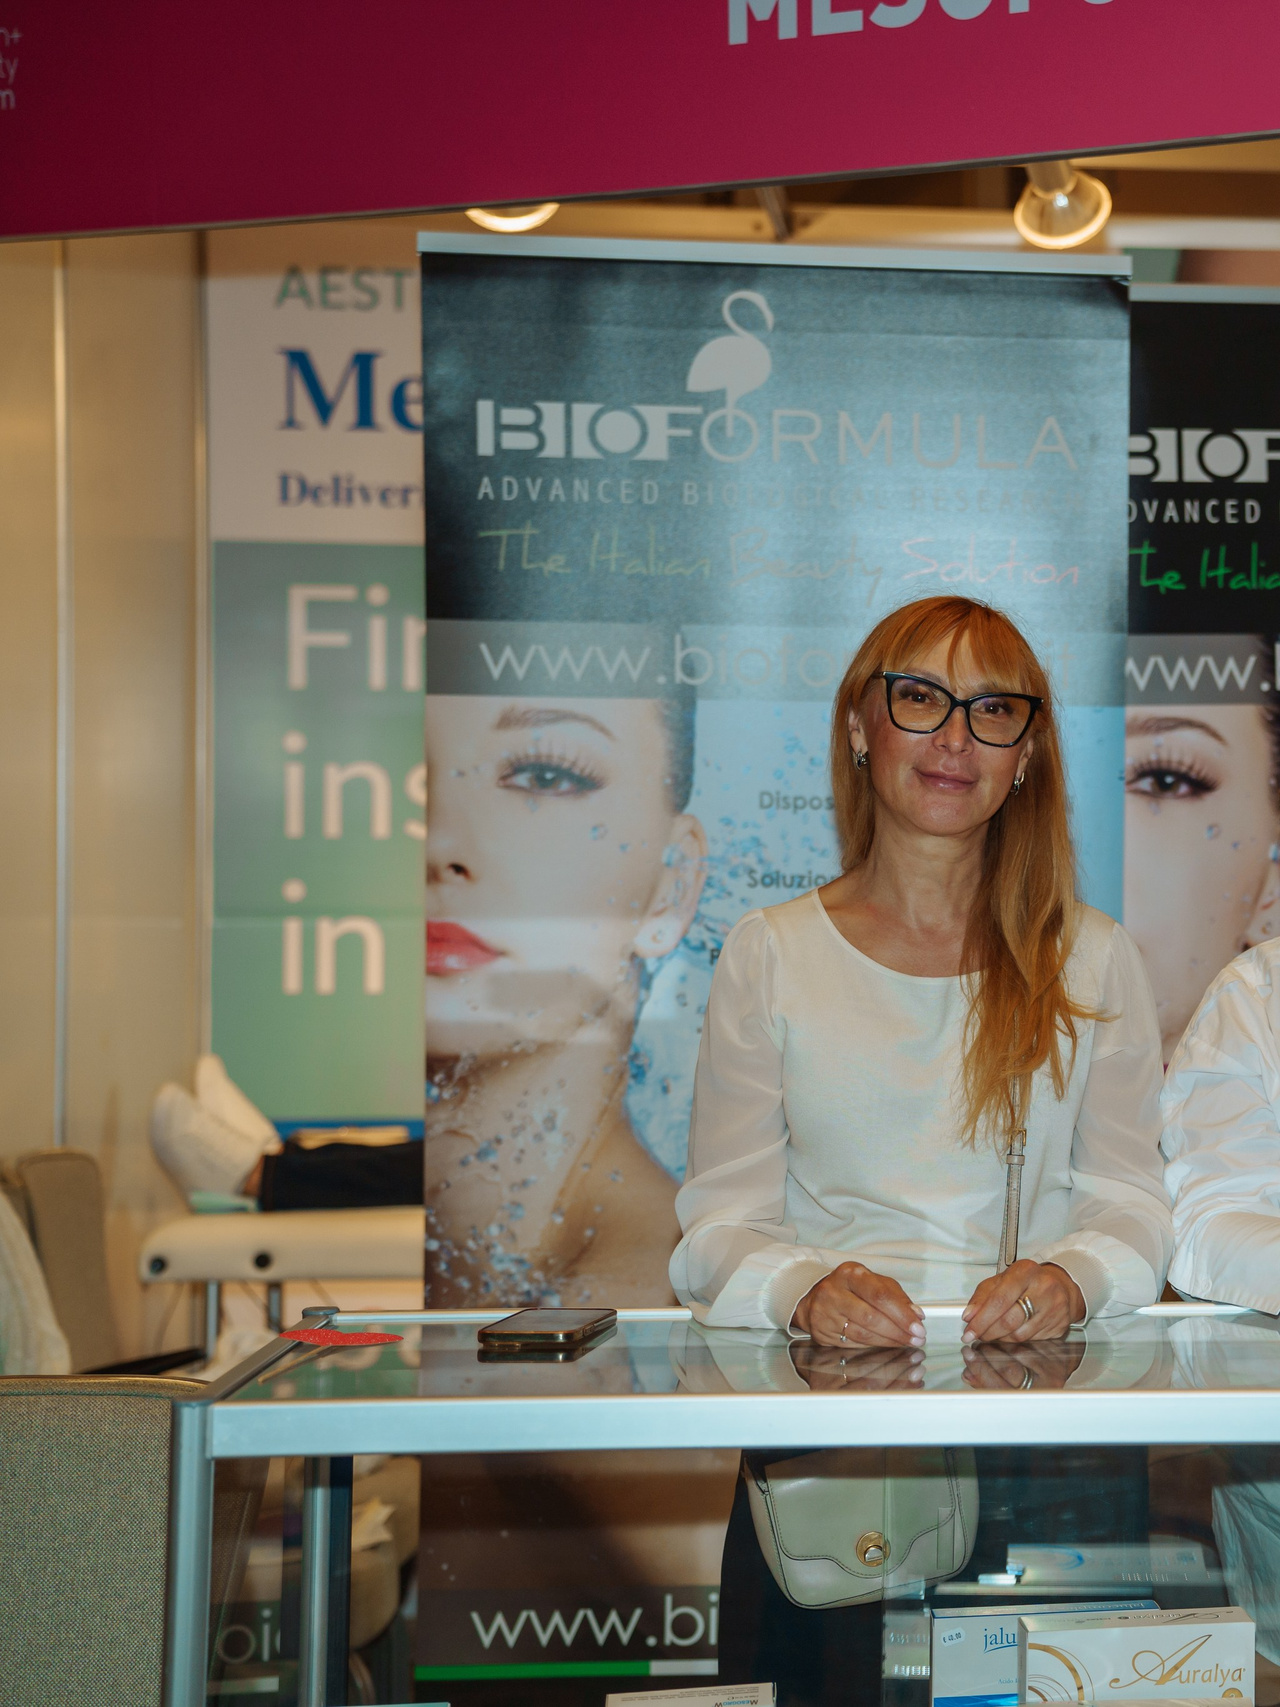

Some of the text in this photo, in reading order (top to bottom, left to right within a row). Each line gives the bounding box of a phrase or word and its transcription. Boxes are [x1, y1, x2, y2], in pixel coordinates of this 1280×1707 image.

[476, 399, 1080, 471] BIOFORMULA
[278, 472, 425, 508] Deliver
[477, 476, 660, 505] ADVANCED
[900, 532, 1080, 586] Solution
[746, 868, 836, 889] Soluzio
[281, 878, 386, 996] in
[470, 1593, 719, 1650] www.bi
[1108, 1634, 1244, 1689] Auralya
